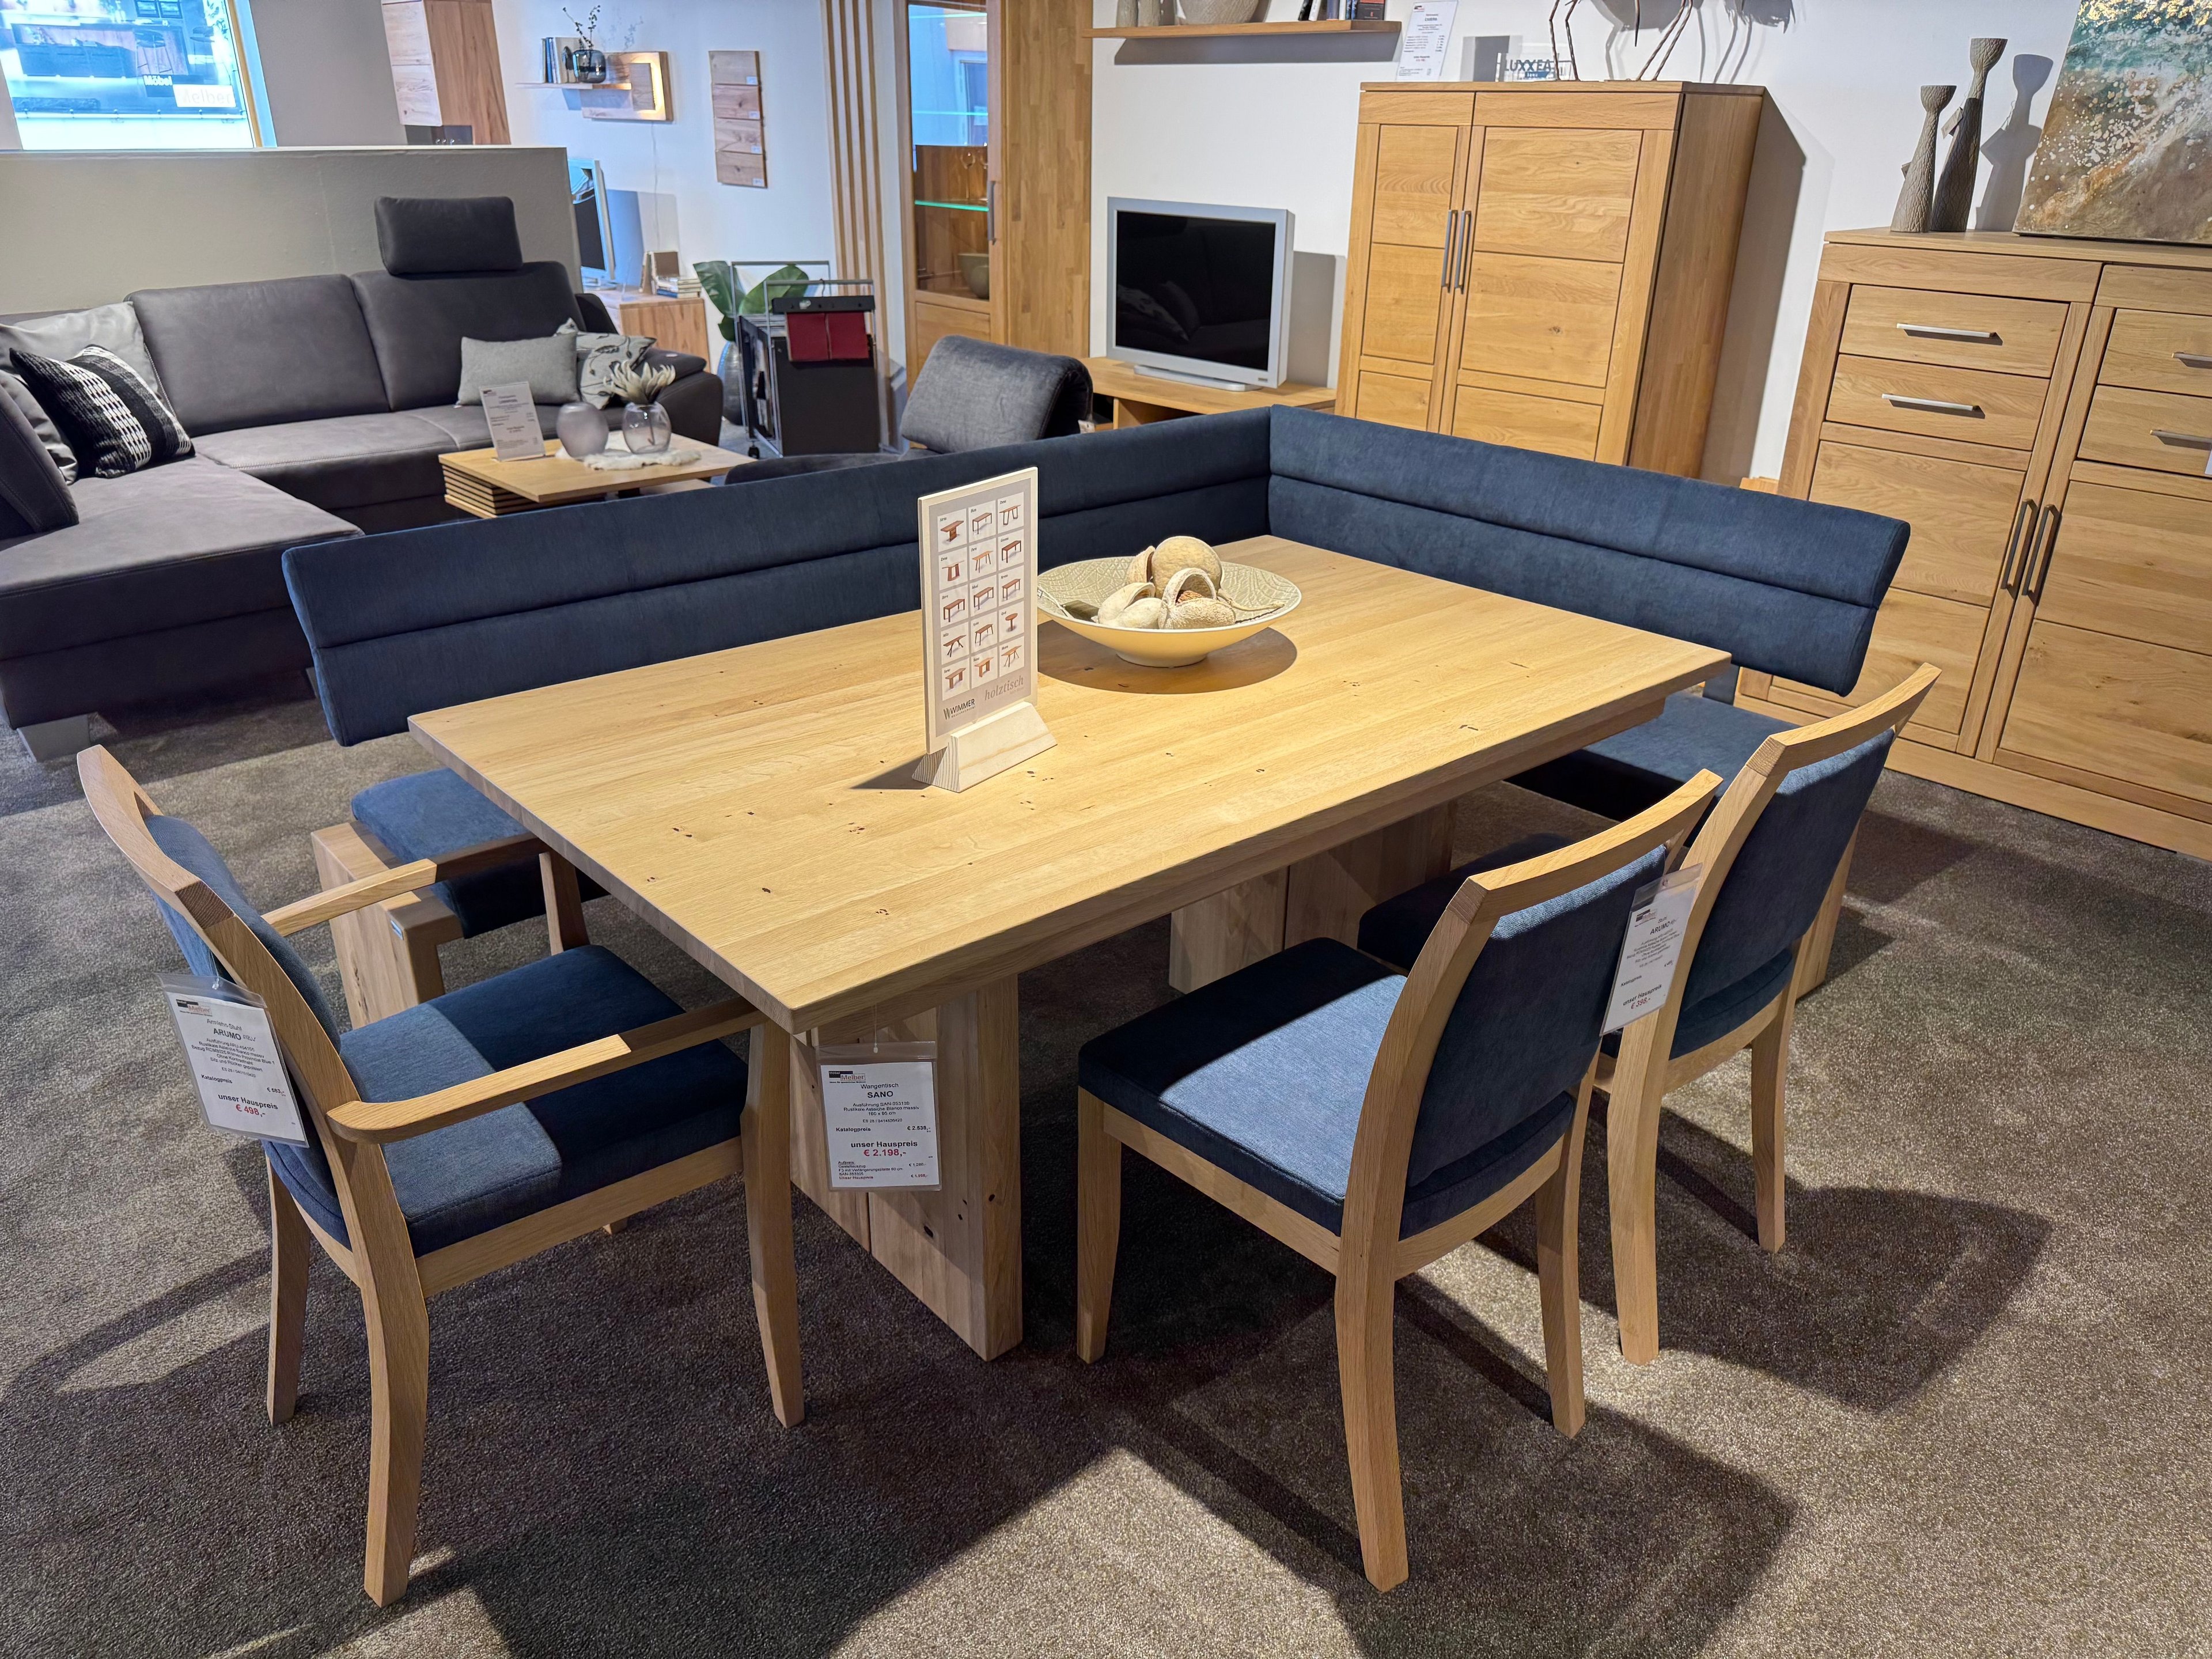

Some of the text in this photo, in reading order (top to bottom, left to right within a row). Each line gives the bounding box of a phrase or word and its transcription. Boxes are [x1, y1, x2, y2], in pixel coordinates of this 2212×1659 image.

[143, 75, 173, 86] Möbel
[984, 675, 1024, 701] holztisch
[950, 698, 975, 714] WIMMER
[1650, 921, 1670, 935] ARUMO
[1623, 984, 1662, 1006] unser Hauspreis
[214, 1028, 241, 1040] ARUMO
[201, 1074, 233, 1084] Katalogpreis
[241, 1097, 278, 1109] Hauspreis
[244, 1106, 266, 1117] 498,-
[877, 1141, 918, 1149] Hauspreis
[873, 1149, 906, 1157] 2.198,-
